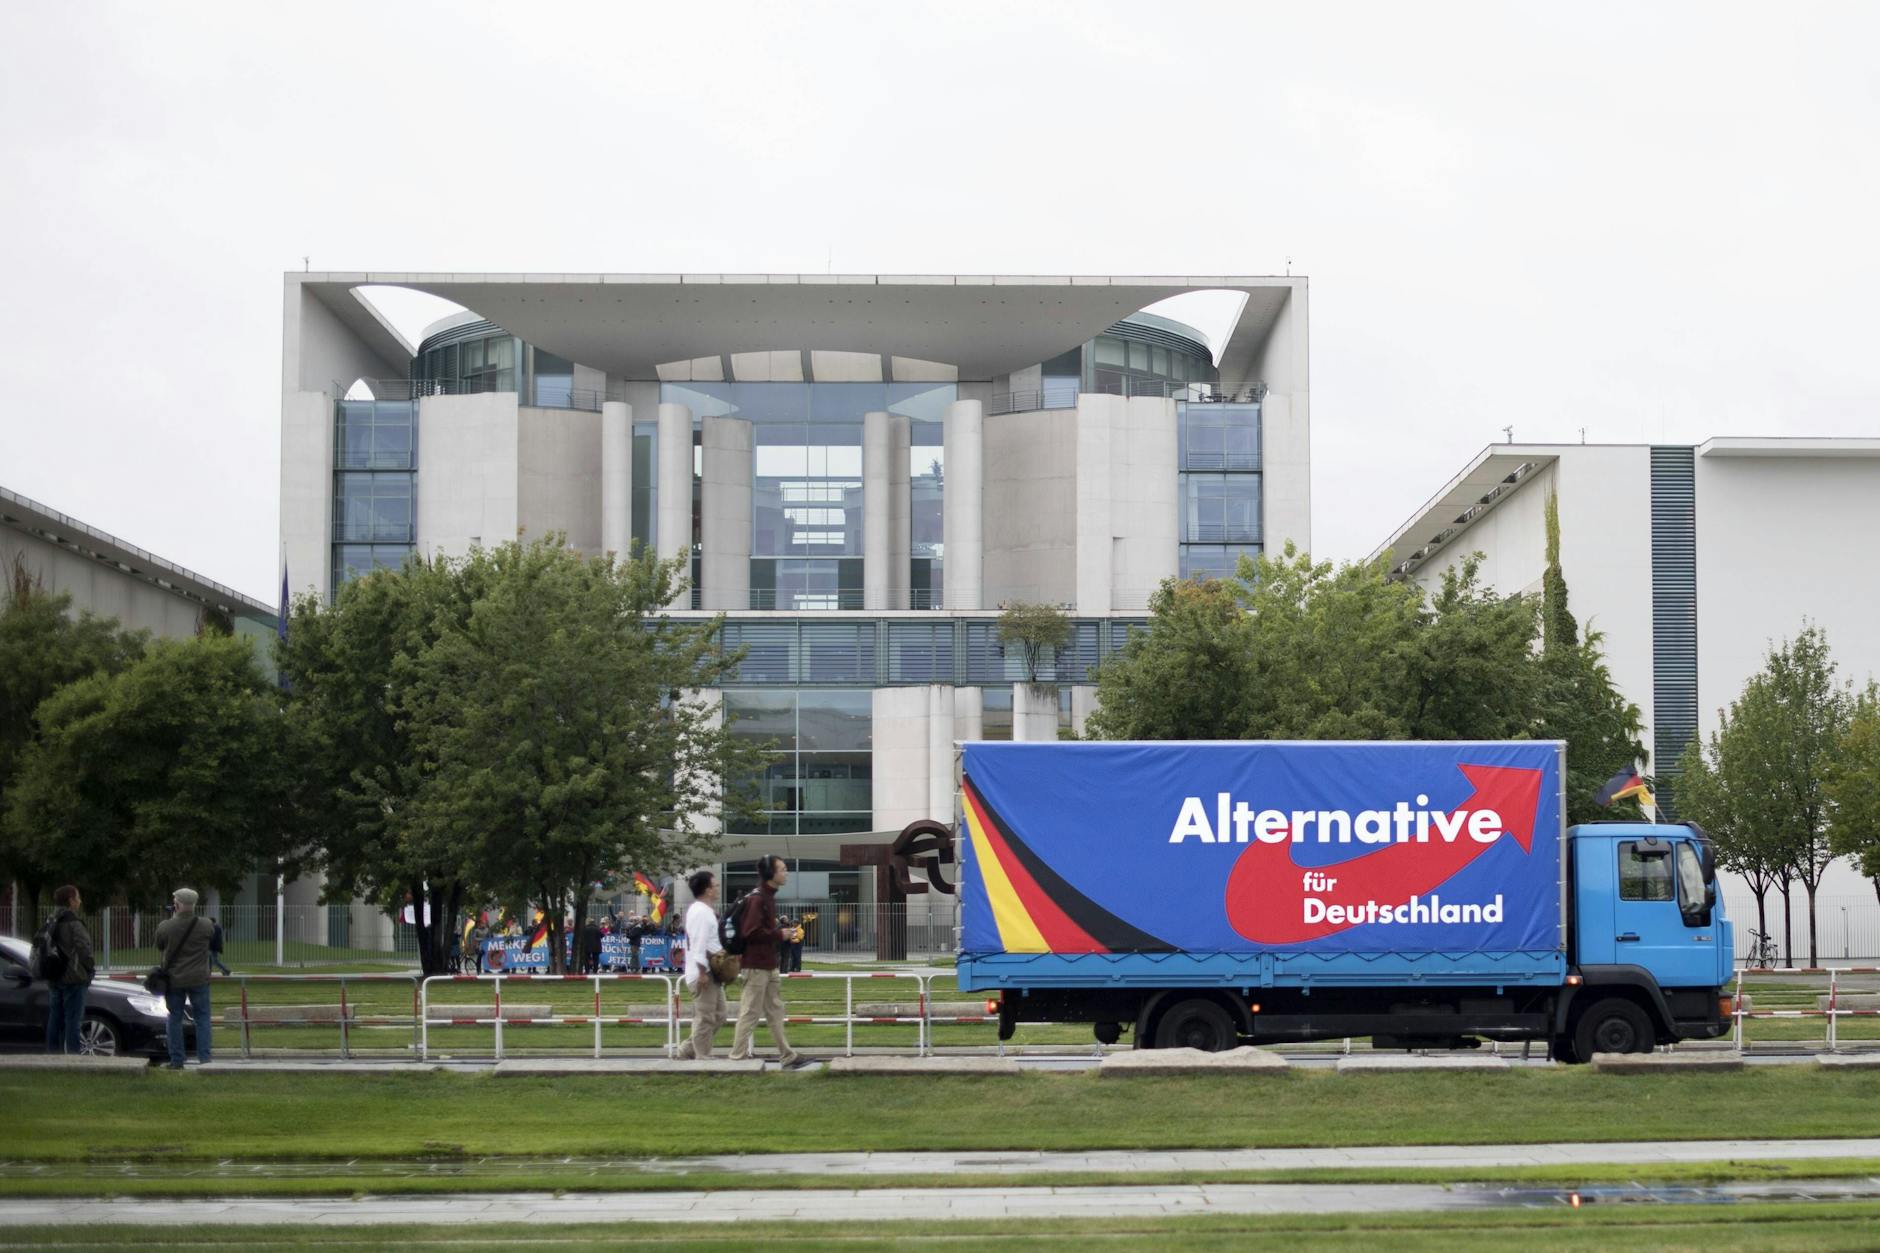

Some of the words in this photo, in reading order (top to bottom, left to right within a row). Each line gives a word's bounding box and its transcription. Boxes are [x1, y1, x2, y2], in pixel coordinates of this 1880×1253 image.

[1168, 792, 1503, 844] Alternative
[1302, 870, 1338, 892] für
[1303, 894, 1504, 924] Deutschland
[512, 952, 545, 962] WEG!
